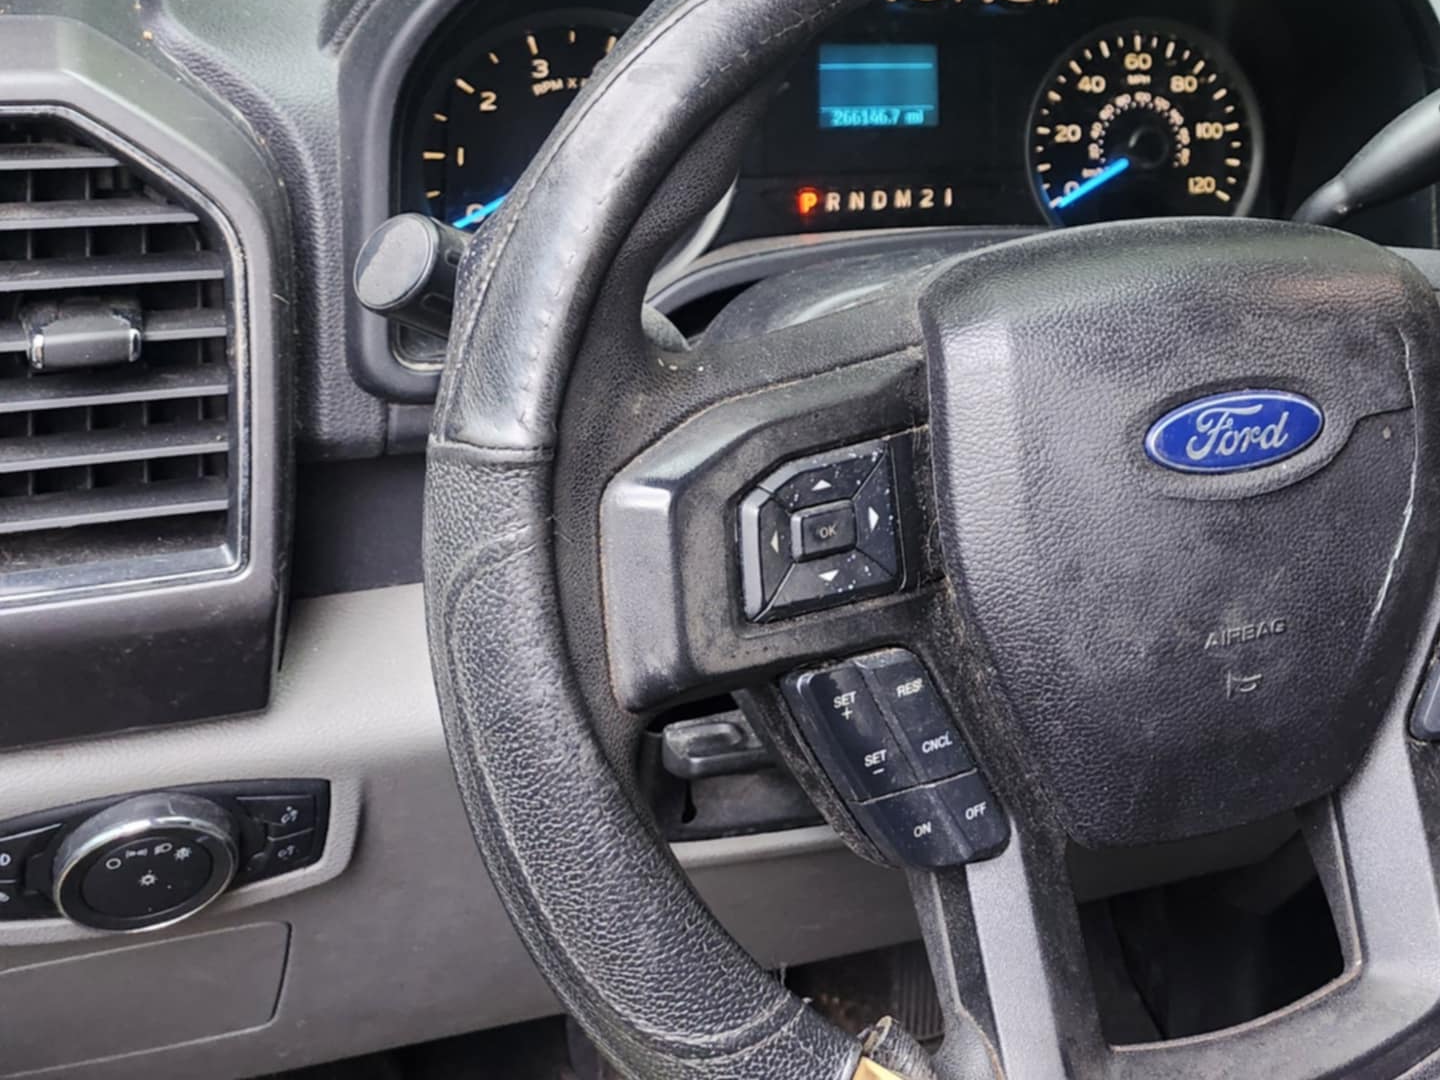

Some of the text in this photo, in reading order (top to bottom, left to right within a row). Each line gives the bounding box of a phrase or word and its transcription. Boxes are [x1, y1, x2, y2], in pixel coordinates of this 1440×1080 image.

[532, 59, 549, 78] 3
[1124, 53, 1152, 70] 60
[532, 78, 563, 96] RPM
[1078, 76, 1106, 93] 40
[1170, 76, 1198, 93] 80
[480, 92, 497, 111] 2
[1054, 124, 1082, 142] 20
[1195, 123, 1223, 139] 100
[457, 147, 464, 166] 1
[1188, 177, 1216, 194] 120
[800, 192, 817, 213] P
[825, 192, 840, 212] R
[848, 191, 865, 210] N
[871, 190, 887, 210] D
[894, 189, 912, 208] M
[919, 188, 934, 208] 2
[1186, 403, 1289, 461] Ford
[819, 524, 837, 538] OK
[1204, 619, 1286, 650] AIRBAG
[833, 690, 857, 709] SET
[921, 730, 953, 753] CNCL
[864, 749, 887, 767] SET
[965, 801, 987, 820] OFF
[913, 822, 931, 838] ON
